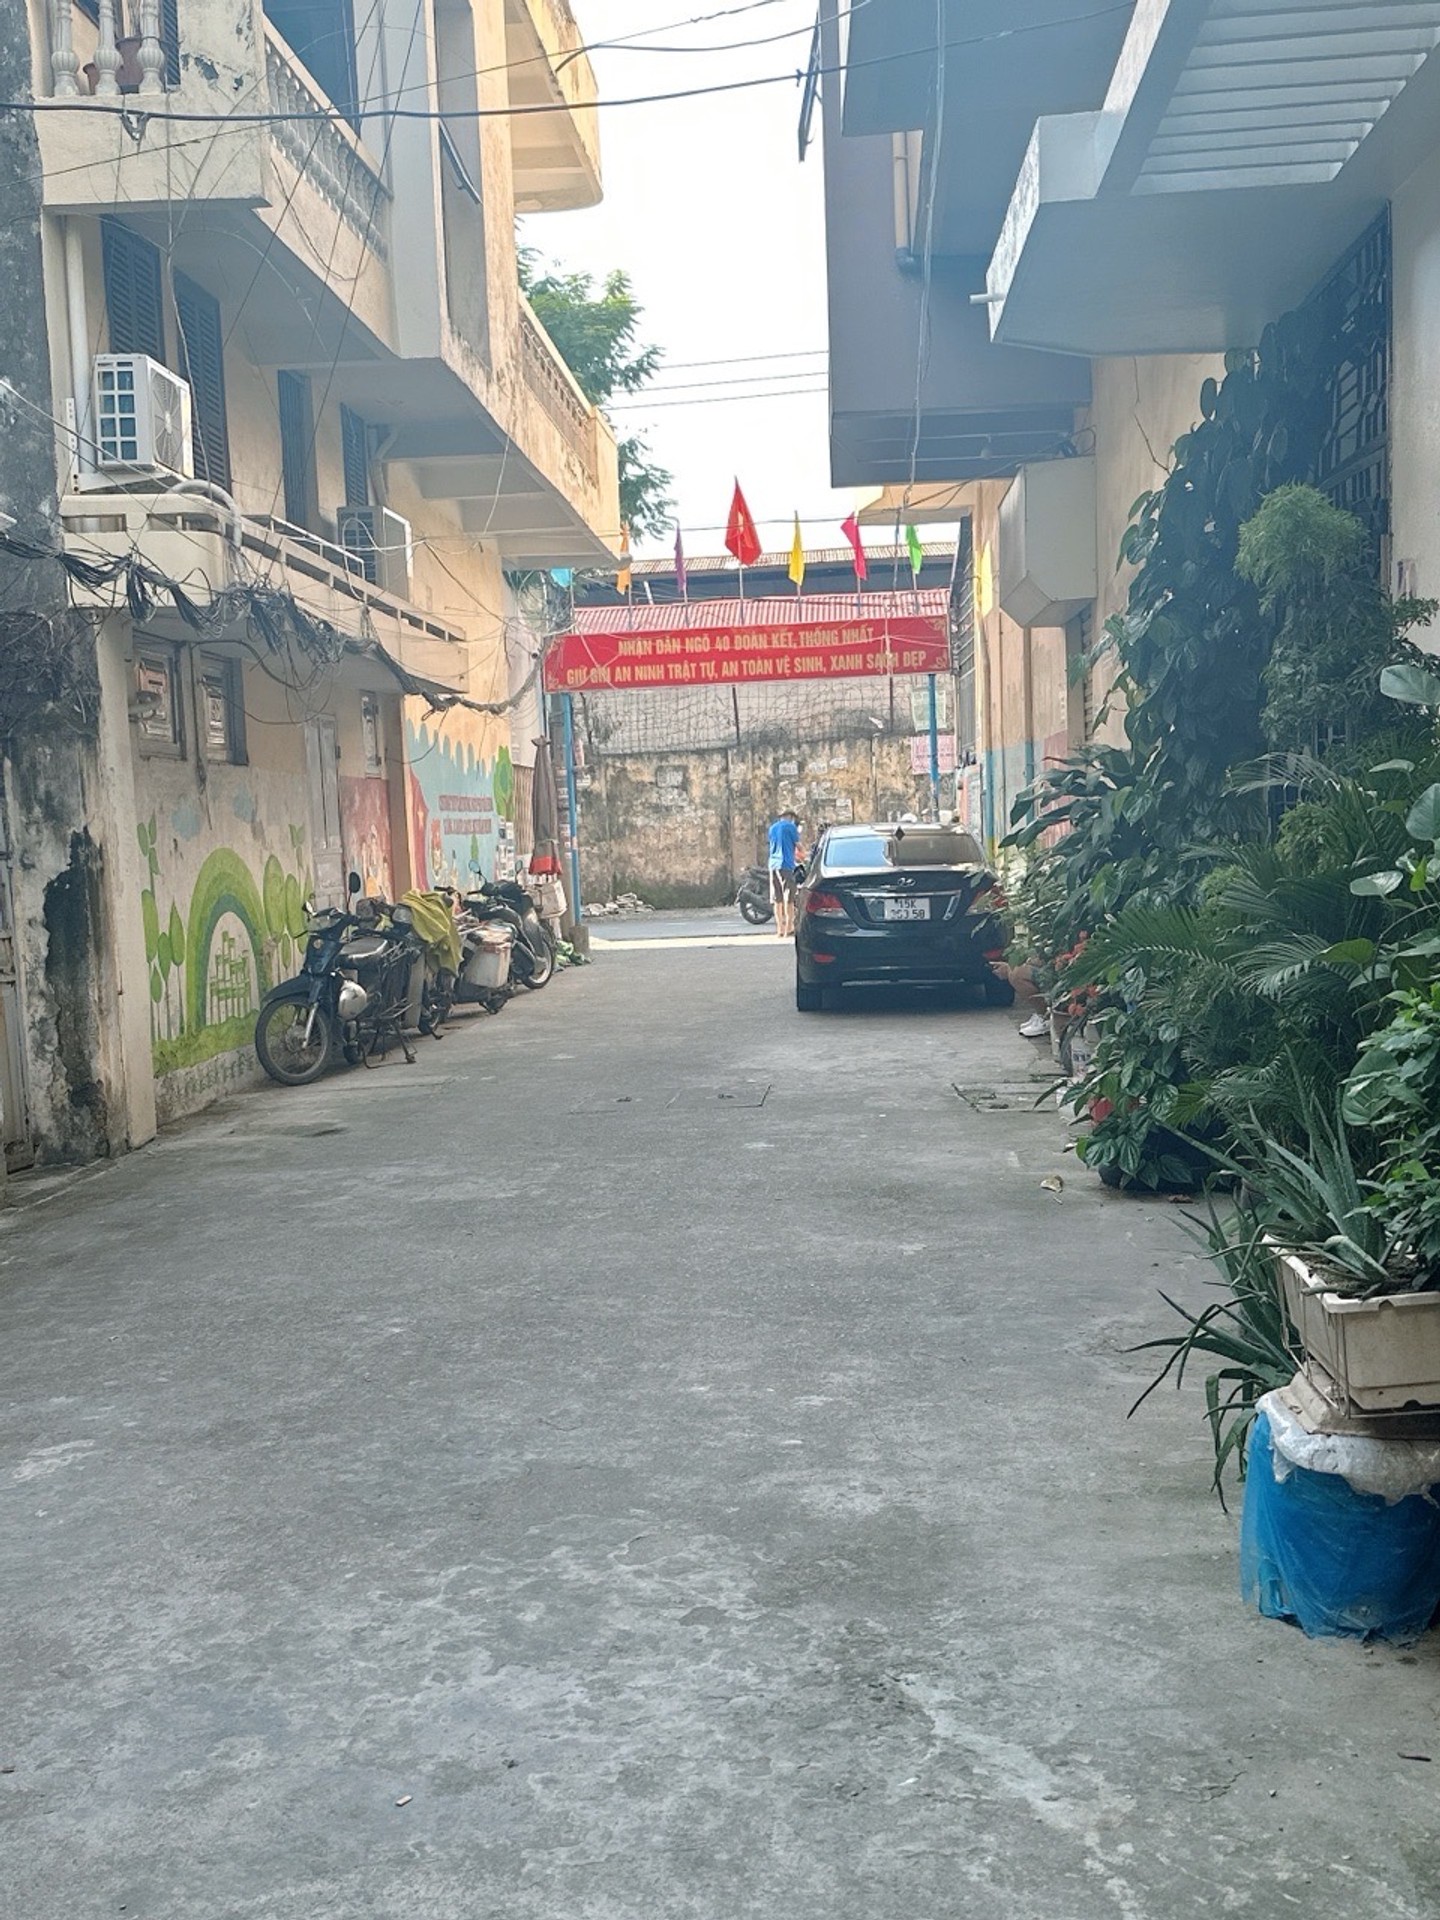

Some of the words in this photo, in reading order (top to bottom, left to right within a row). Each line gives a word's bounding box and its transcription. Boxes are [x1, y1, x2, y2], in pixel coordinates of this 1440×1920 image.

[685, 634, 710, 653] NGÕ
[715, 635, 730, 652] 40
[734, 631, 768, 650] ĐOÀN
[799, 626, 838, 647] THỐNG
[842, 624, 874, 644] NHẤT
[615, 666, 631, 682] AN
[635, 664, 665, 681] NINH
[667, 660, 696, 682] TRẬT
[700, 660, 718, 681] TỰ,
[722, 661, 738, 677] AN
[741, 656, 773, 676] TOÀN
[776, 655, 791, 677] VỆ
[794, 656, 826, 674] SINH,
[830, 654, 863, 671] XANH
[903, 651, 927, 670] ĐẸP
